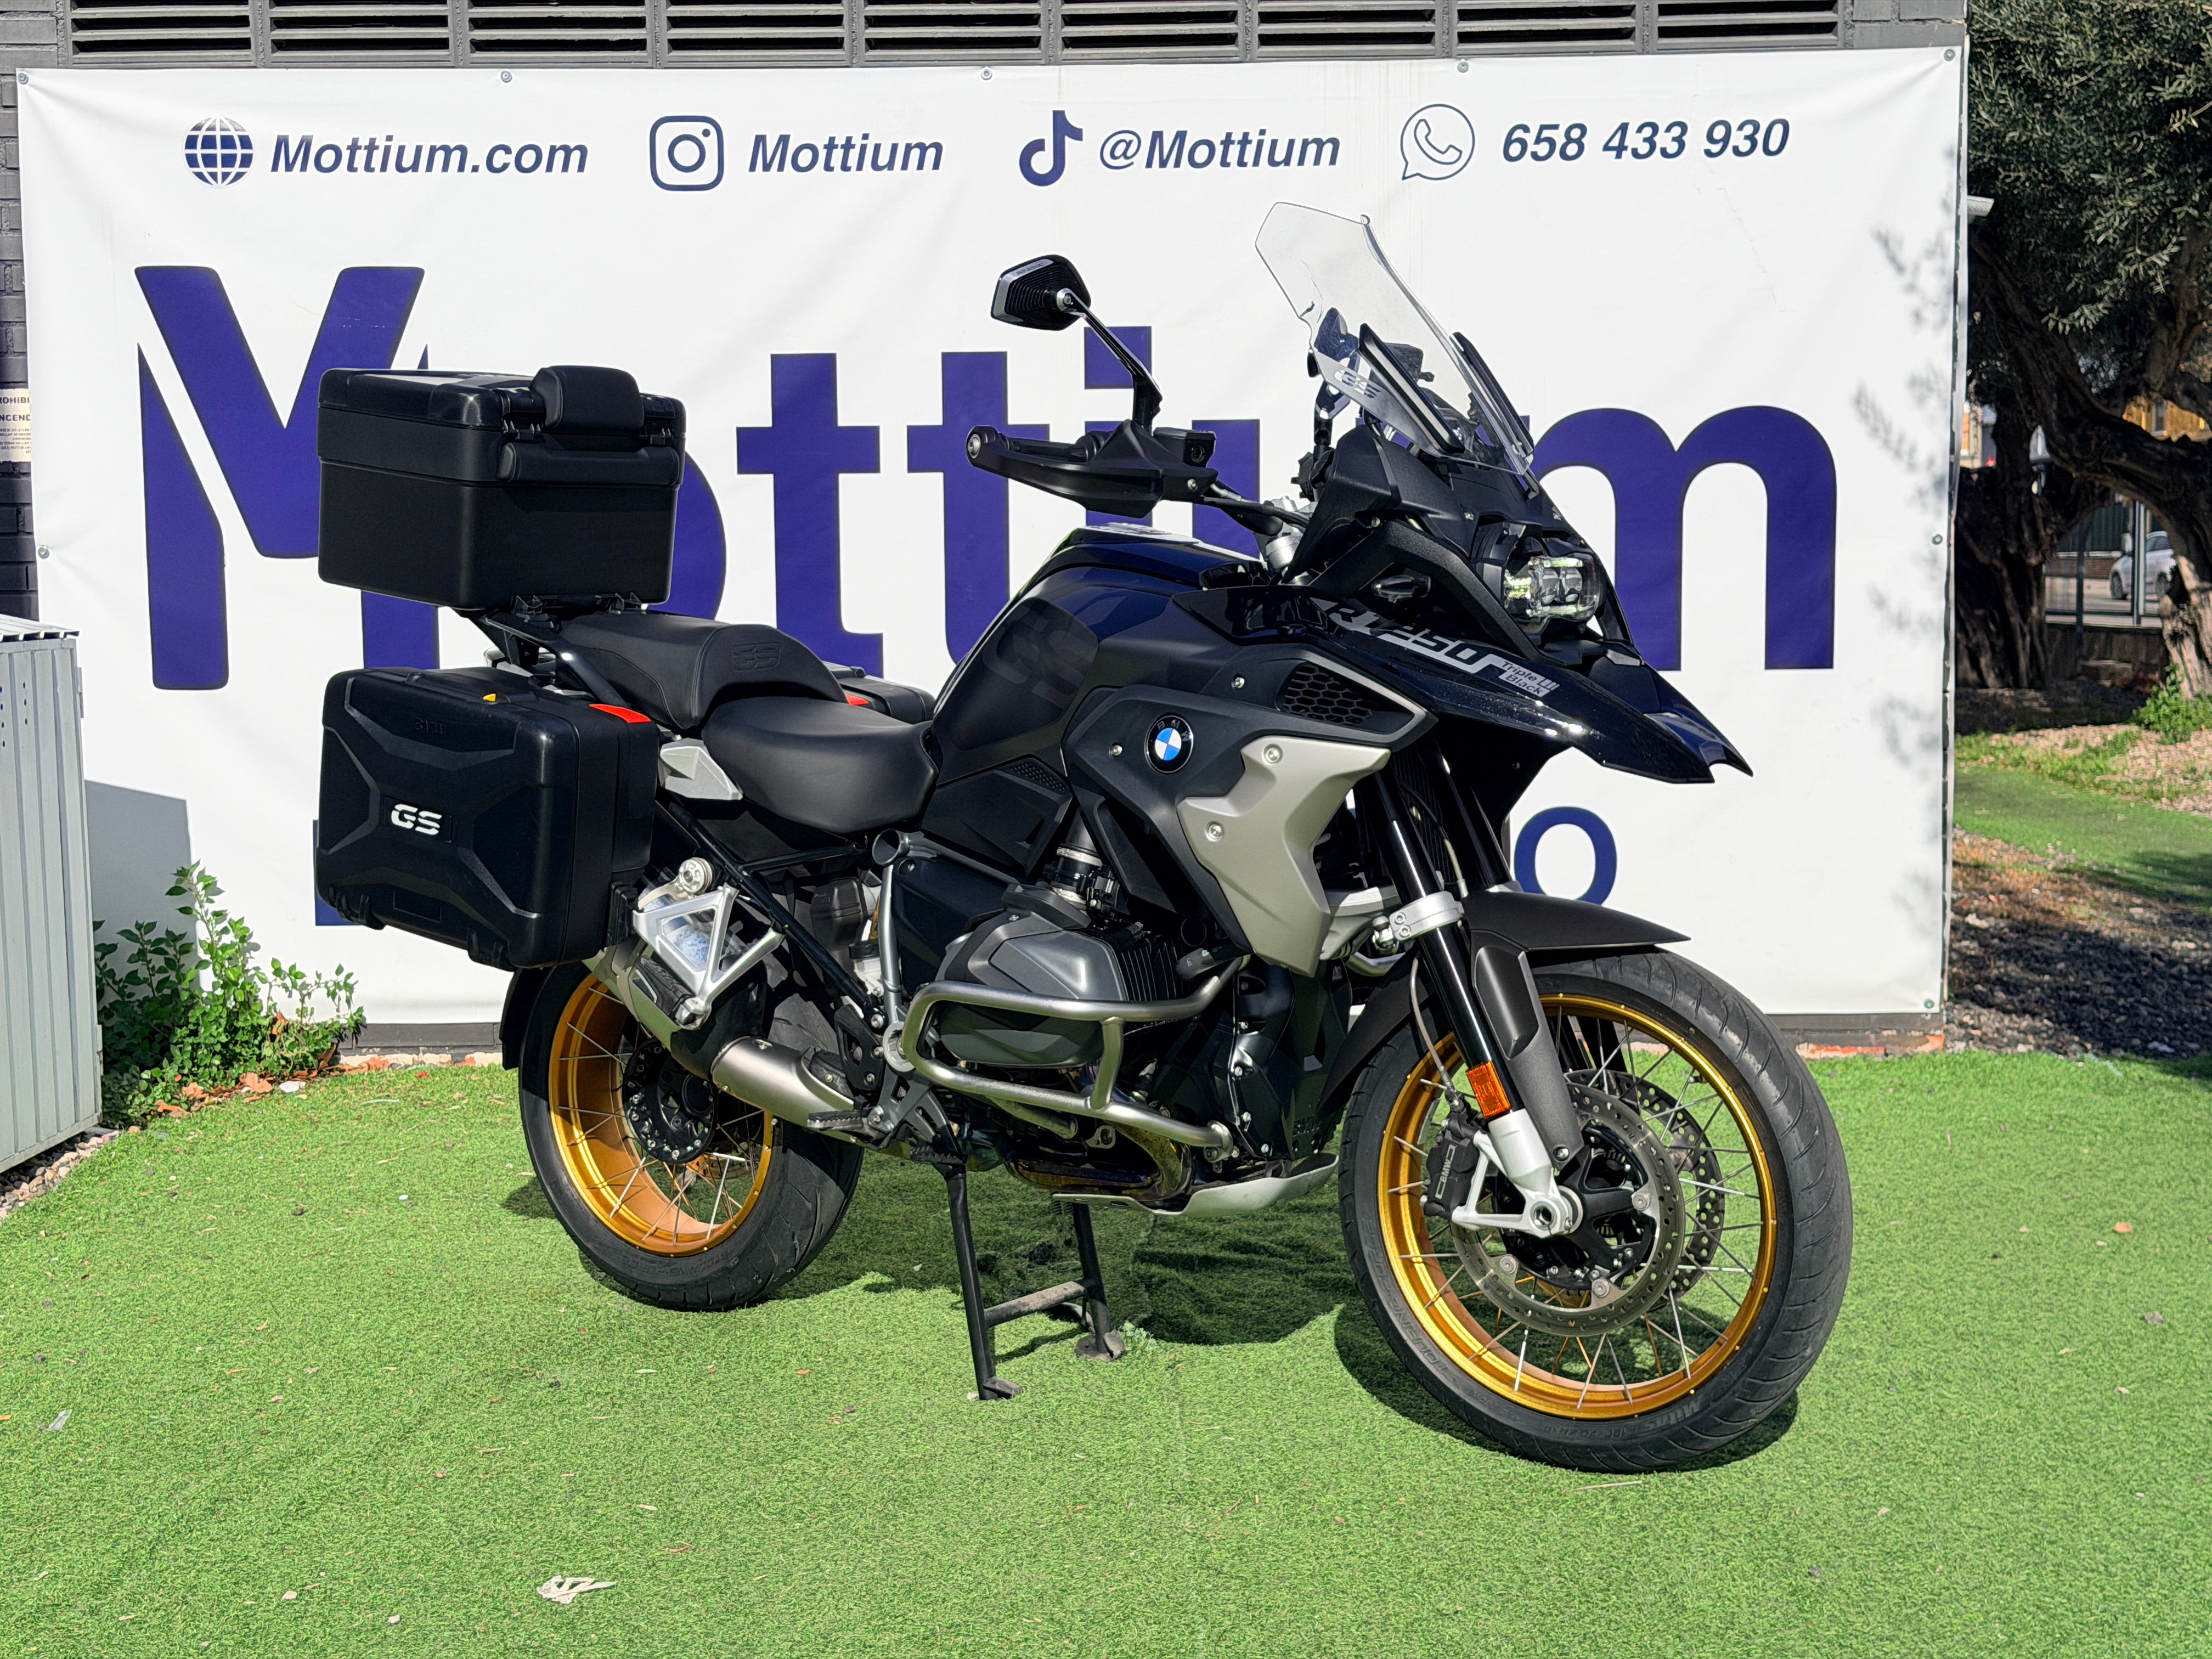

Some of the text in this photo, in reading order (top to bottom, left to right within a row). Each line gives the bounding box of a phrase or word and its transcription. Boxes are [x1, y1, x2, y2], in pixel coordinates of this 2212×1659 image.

[270, 134, 589, 174] Mottium.com
[748, 132, 944, 173] Mottium
[1099, 128, 1340, 171] @Mottium
[1502, 118, 1790, 163] 658 433 930
[1334, 370, 1381, 399] GS
[134, 266, 1837, 691] Mttim
[1502, 661, 1537, 681] Triple
[1505, 674, 1543, 695] Black
[1157, 718, 1192, 742] BMW
[391, 804, 442, 836] GS
[1440, 1158, 1452, 1183] BMW
